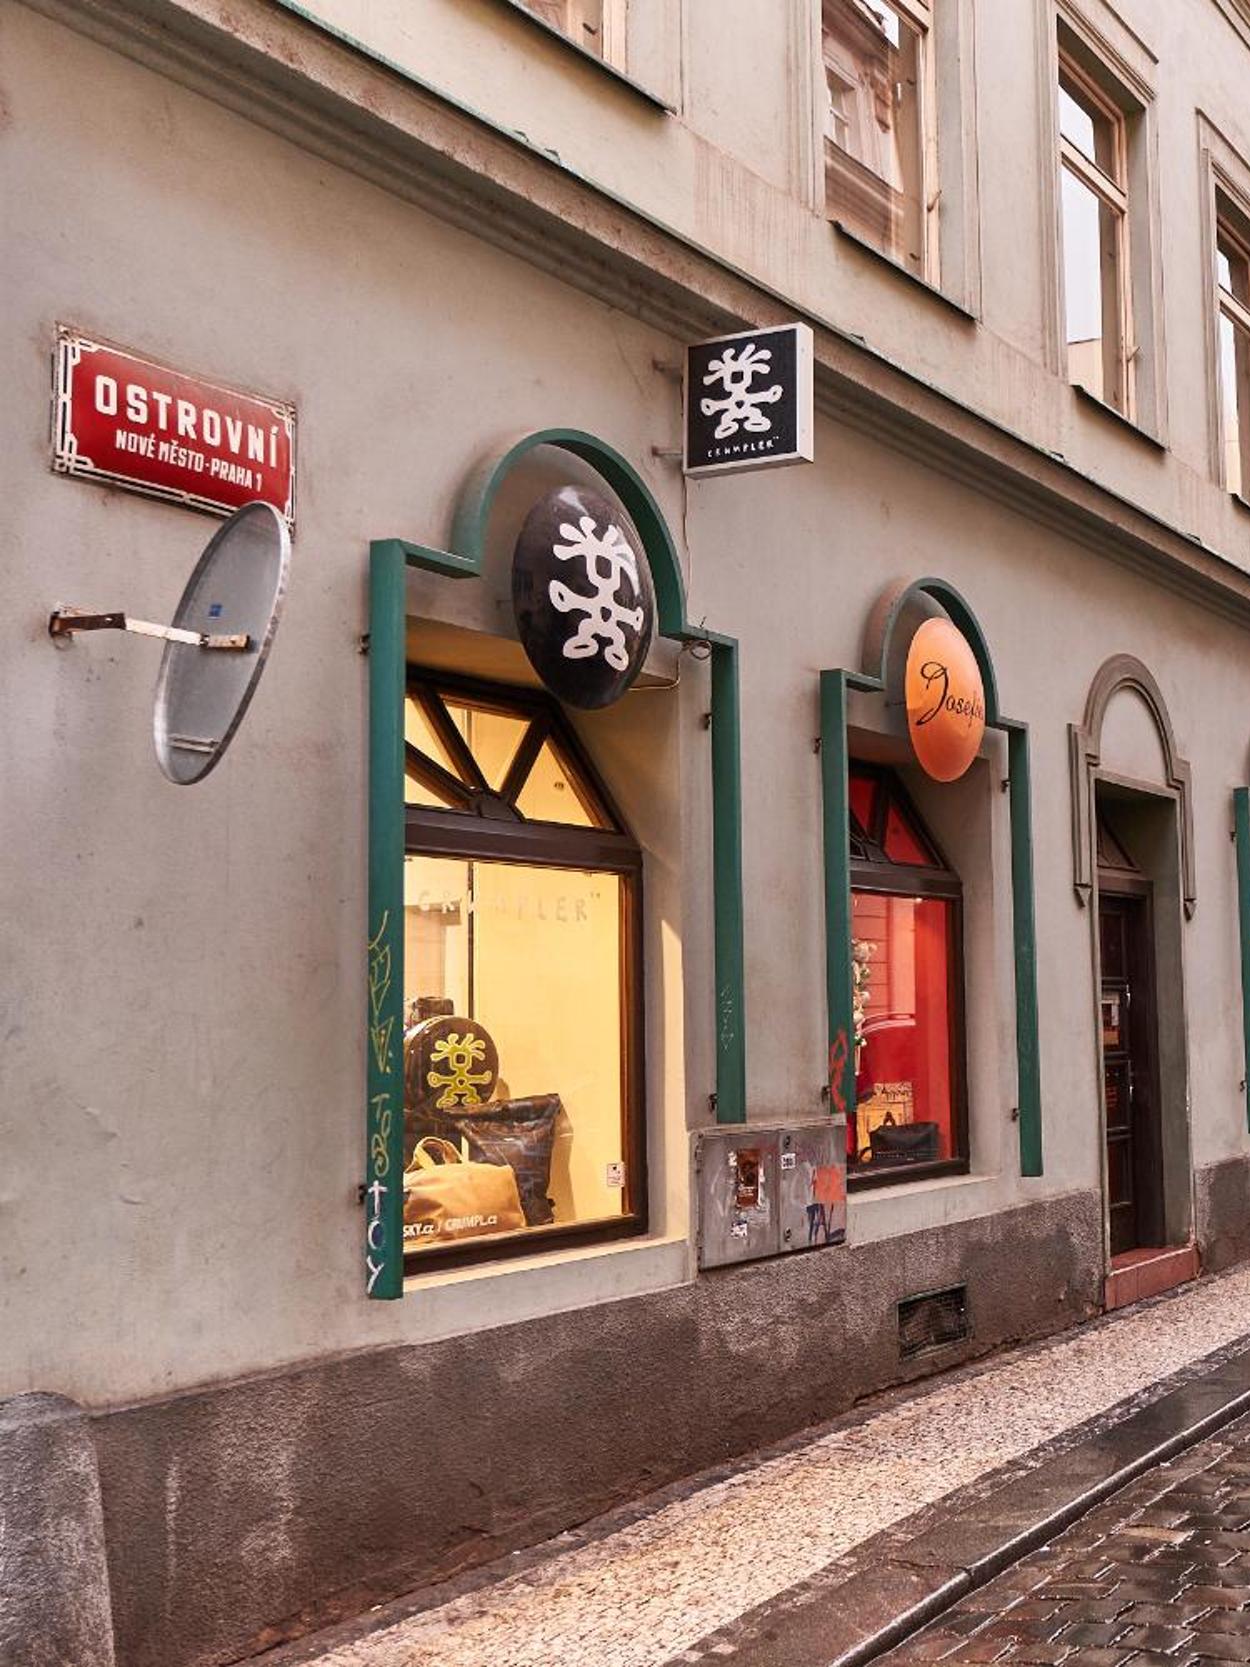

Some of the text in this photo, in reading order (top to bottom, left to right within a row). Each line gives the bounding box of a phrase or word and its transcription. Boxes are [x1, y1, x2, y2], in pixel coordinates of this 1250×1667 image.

[94, 374, 279, 468] OSTROVNÍ
[115, 429, 155, 458] NOVÉ
[256, 472, 263, 491] 1
